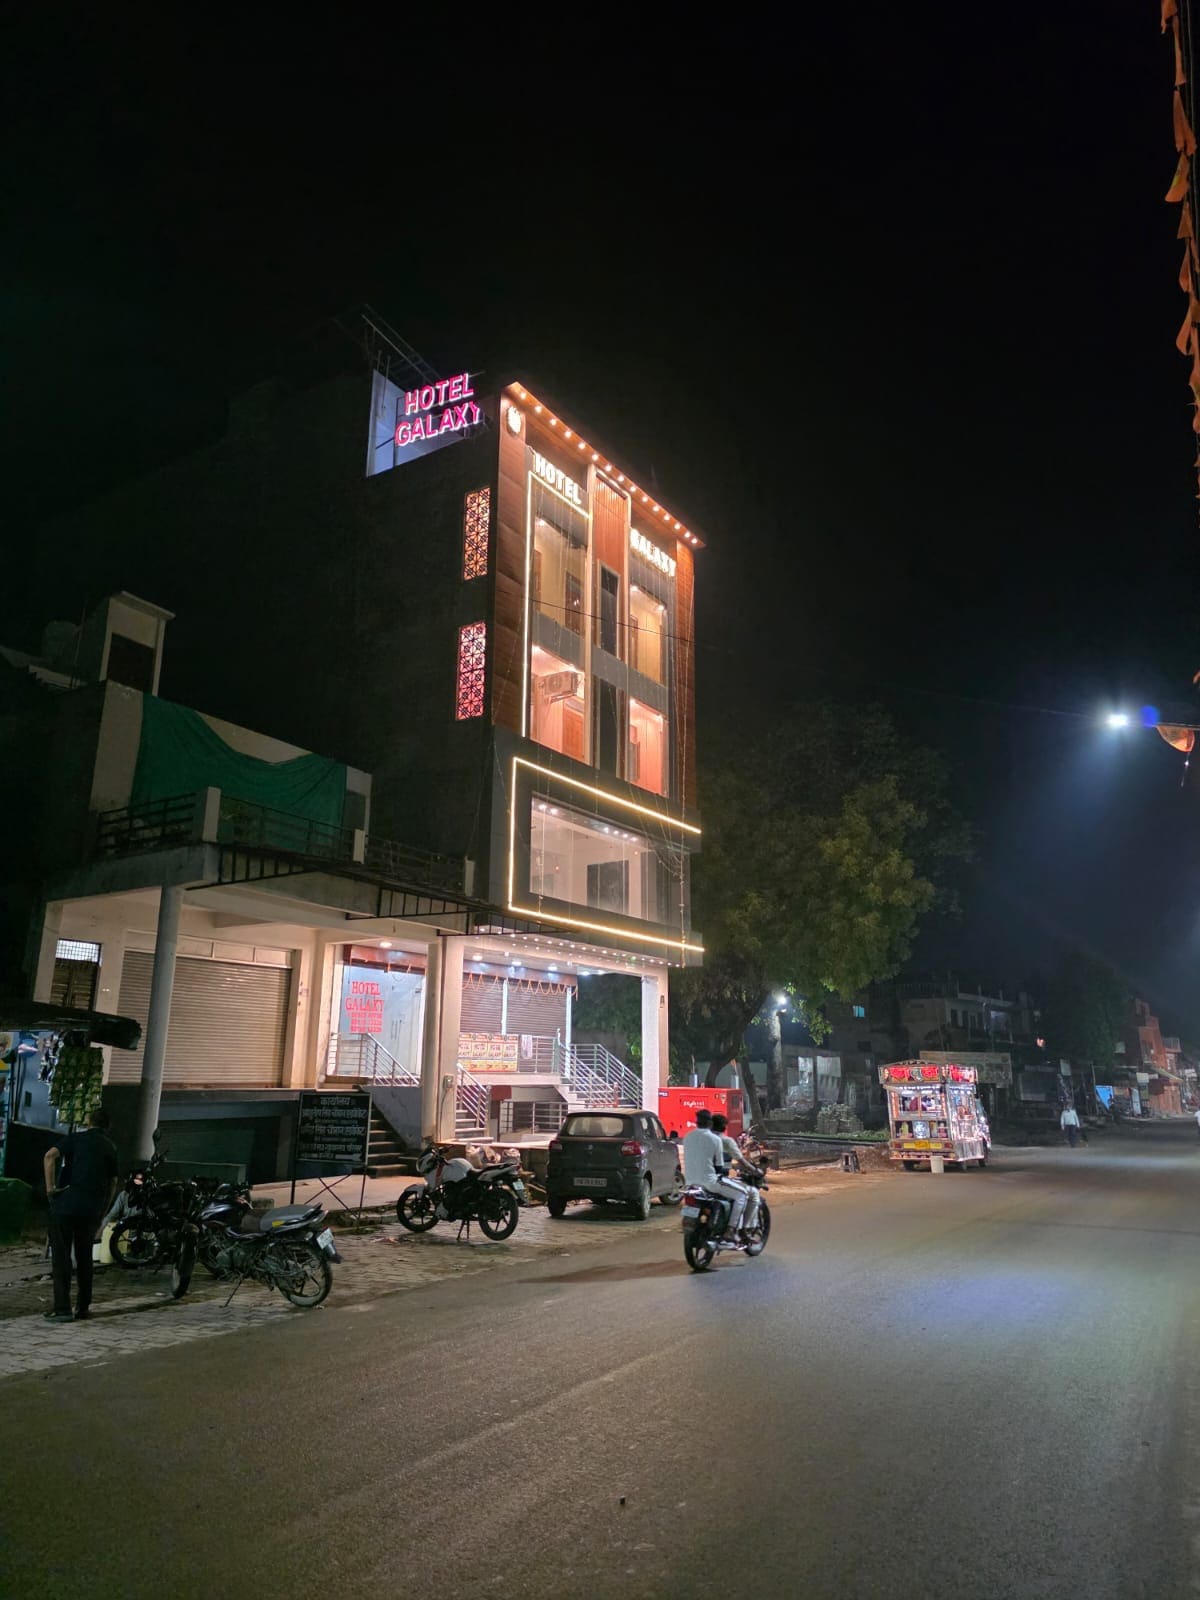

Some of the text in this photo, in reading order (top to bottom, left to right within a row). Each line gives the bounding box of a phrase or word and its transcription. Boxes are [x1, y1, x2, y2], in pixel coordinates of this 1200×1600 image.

[404, 372, 475, 415] HOTEL
[394, 400, 481, 448] GALAXY
[533, 451, 583, 506] HOTEL
[629, 527, 677, 578] GALAXY
[345, 997, 385, 1012] GALAXY
[351, 981, 381, 996] HOTEL
